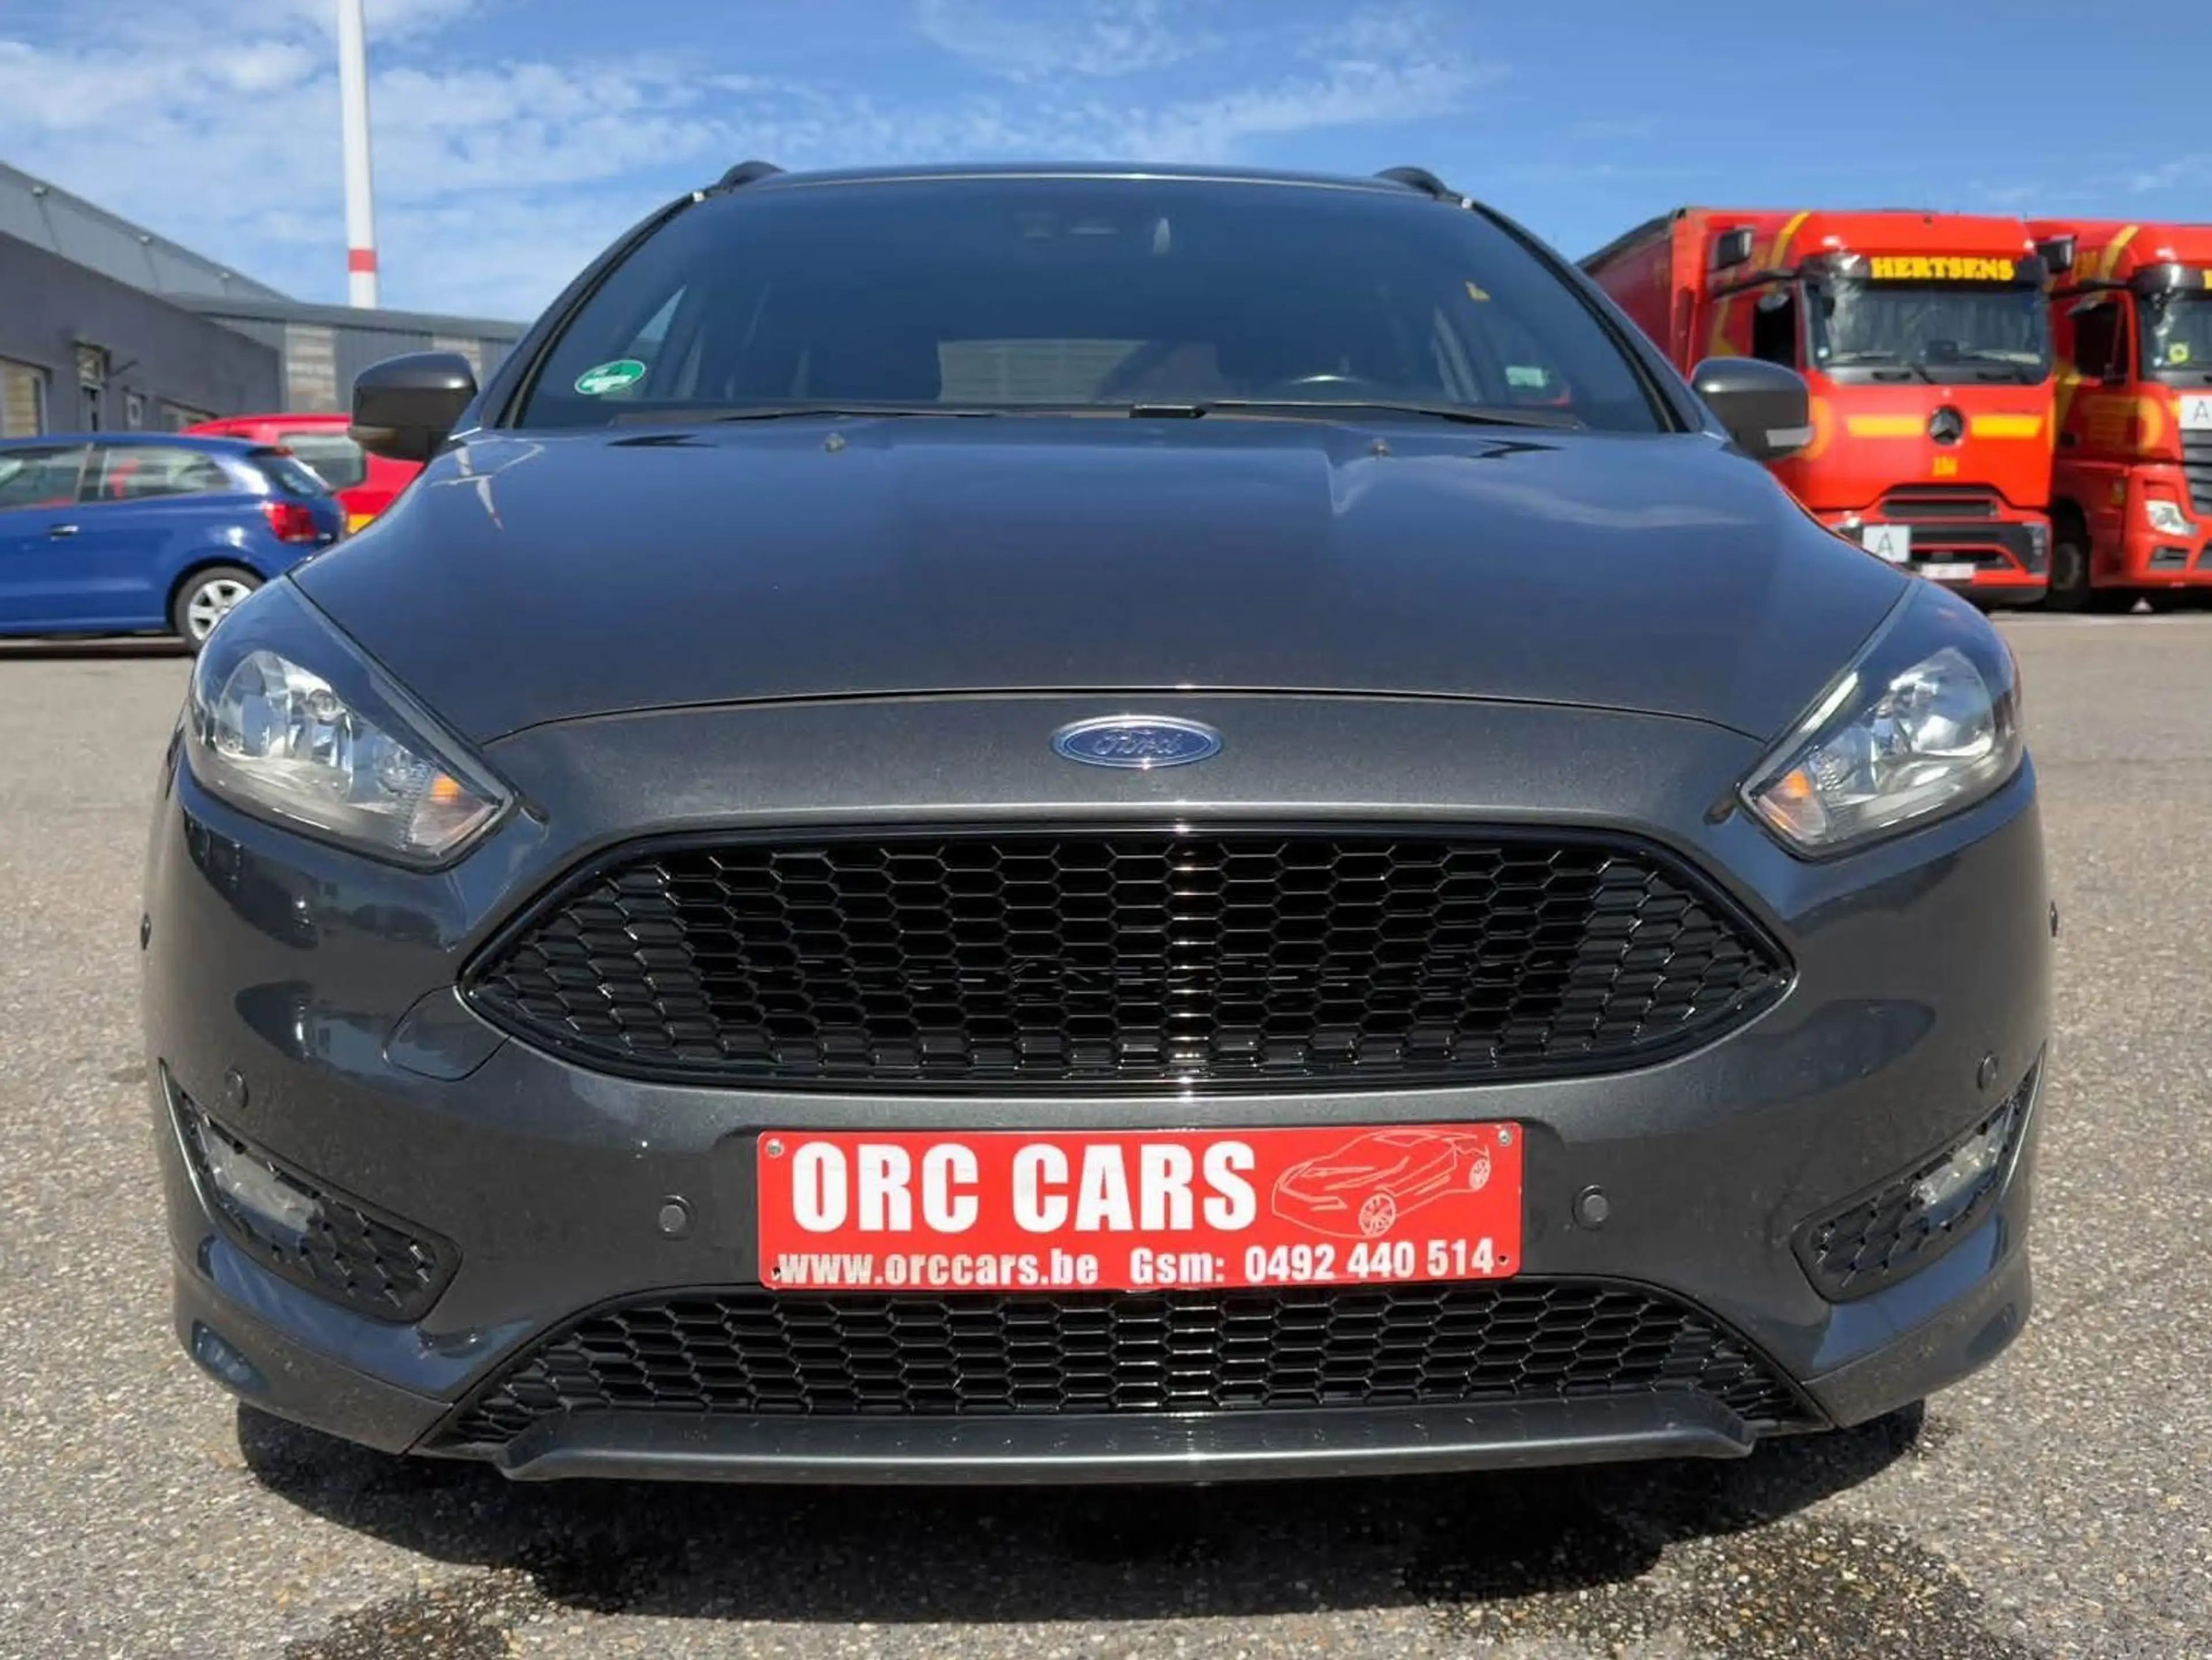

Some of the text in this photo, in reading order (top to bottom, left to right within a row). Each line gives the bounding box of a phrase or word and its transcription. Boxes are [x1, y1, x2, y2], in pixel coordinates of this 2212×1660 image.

[1871, 256, 2015, 280] HERTSENS
[1877, 531, 1894, 555] A
[792, 1141, 1257, 1233] ORC CARS
[778, 1238, 1495, 1285] www.orccars.be Gsm: 0492 440 514
